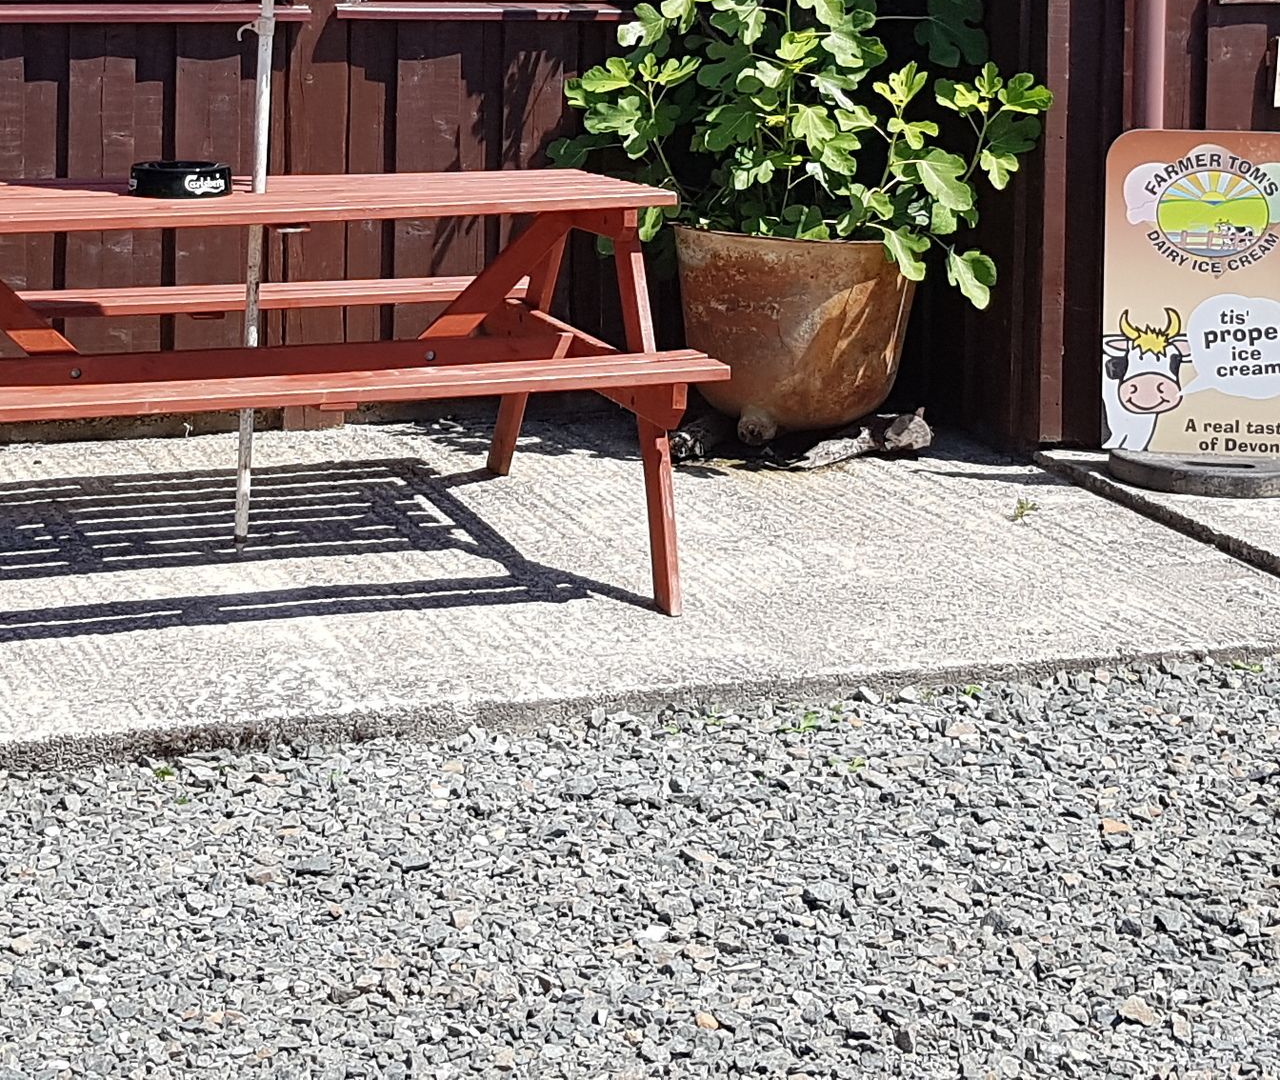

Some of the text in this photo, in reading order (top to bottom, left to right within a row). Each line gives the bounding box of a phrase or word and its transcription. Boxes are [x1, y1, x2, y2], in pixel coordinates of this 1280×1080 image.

[185, 174, 225, 195] Carlsberg
[1144, 153, 1279, 197] FARMER TOM'S
[1146, 229, 1280, 273] DAIRY ICE CREAM
[1231, 346, 1262, 362] ice
[1184, 418, 1197, 433] A
[1203, 419, 1240, 434] real
[1198, 437, 1280, 454] of Devon
